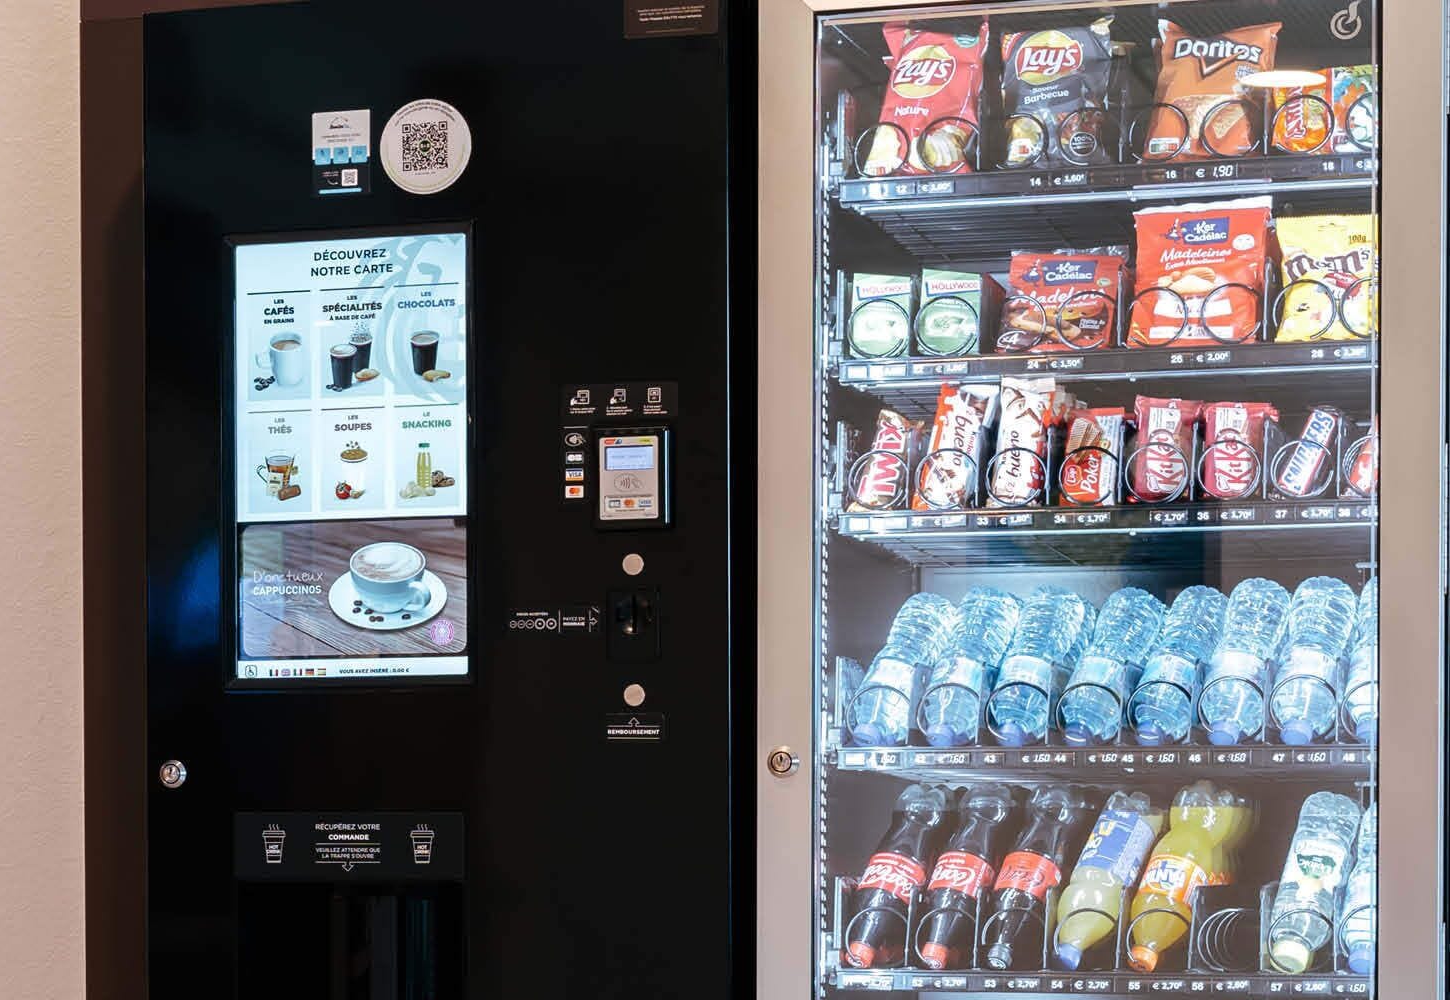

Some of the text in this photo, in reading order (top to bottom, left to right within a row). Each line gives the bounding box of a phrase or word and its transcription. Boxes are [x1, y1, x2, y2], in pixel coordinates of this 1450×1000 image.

[1175, 39, 1261, 64] Doritos
[1020, 46, 1078, 76] Lay's
[894, 60, 951, 86] Lay's
[1024, 89, 1070, 105] Barbecue
[894, 104, 929, 117] Nature
[1165, 170, 1177, 179] 16
[1196, 169, 1205, 178] €
[314, 248, 387, 262] DÉCOUVREZ
[1160, 247, 1232, 263] Madeleines
[311, 263, 394, 277] NOTRE CARTE
[322, 301, 383, 313] SPÉCIALITÉS
[397, 299, 456, 309] CHOCOLATS
[264, 305, 295, 316] CAFÉS
[1196, 355, 1204, 363] €
[1027, 360, 1039, 369] 24
[1050, 361, 1058, 369] €
[334, 422, 372, 432] SOUPES
[402, 419, 452, 429] SNACKING
[268, 424, 293, 435] THÉS
[1080, 454, 1100, 494] Poker
[1154, 513, 1161, 521] €
[1275, 509, 1287, 519] 37
[1301, 510, 1309, 518] €
[999, 517, 1007, 525] €
[1054, 515, 1066, 524] 34
[1077, 515, 1085, 523] €
[253, 585, 322, 596] CAPPUCCINOS
[984, 754, 996, 763] 43
[1022, 755, 1030, 763] €
[1054, 754, 1066, 763] 44
[1088, 755, 1096, 763] €
[1121, 754, 1134, 763] 45
[1146, 754, 1153, 763] €
[1217, 754, 1225, 762] €
[1272, 753, 1285, 762] 47
[1297, 754, 1304, 762] €
[315, 821, 381, 831] RÉCUPÉREZ VOTRE
[984, 979, 996, 988] 53
[1007, 980, 1015, 988] €
[1051, 979, 1063, 989] 54
[1074, 980, 1083, 990] €
[1128, 981, 1140, 991] 55
[1152, 982, 1159, 990] €
[1215, 982, 1223, 990] €
[1271, 982, 1302, 991] 57 €
[1336, 984, 1343, 992] €
